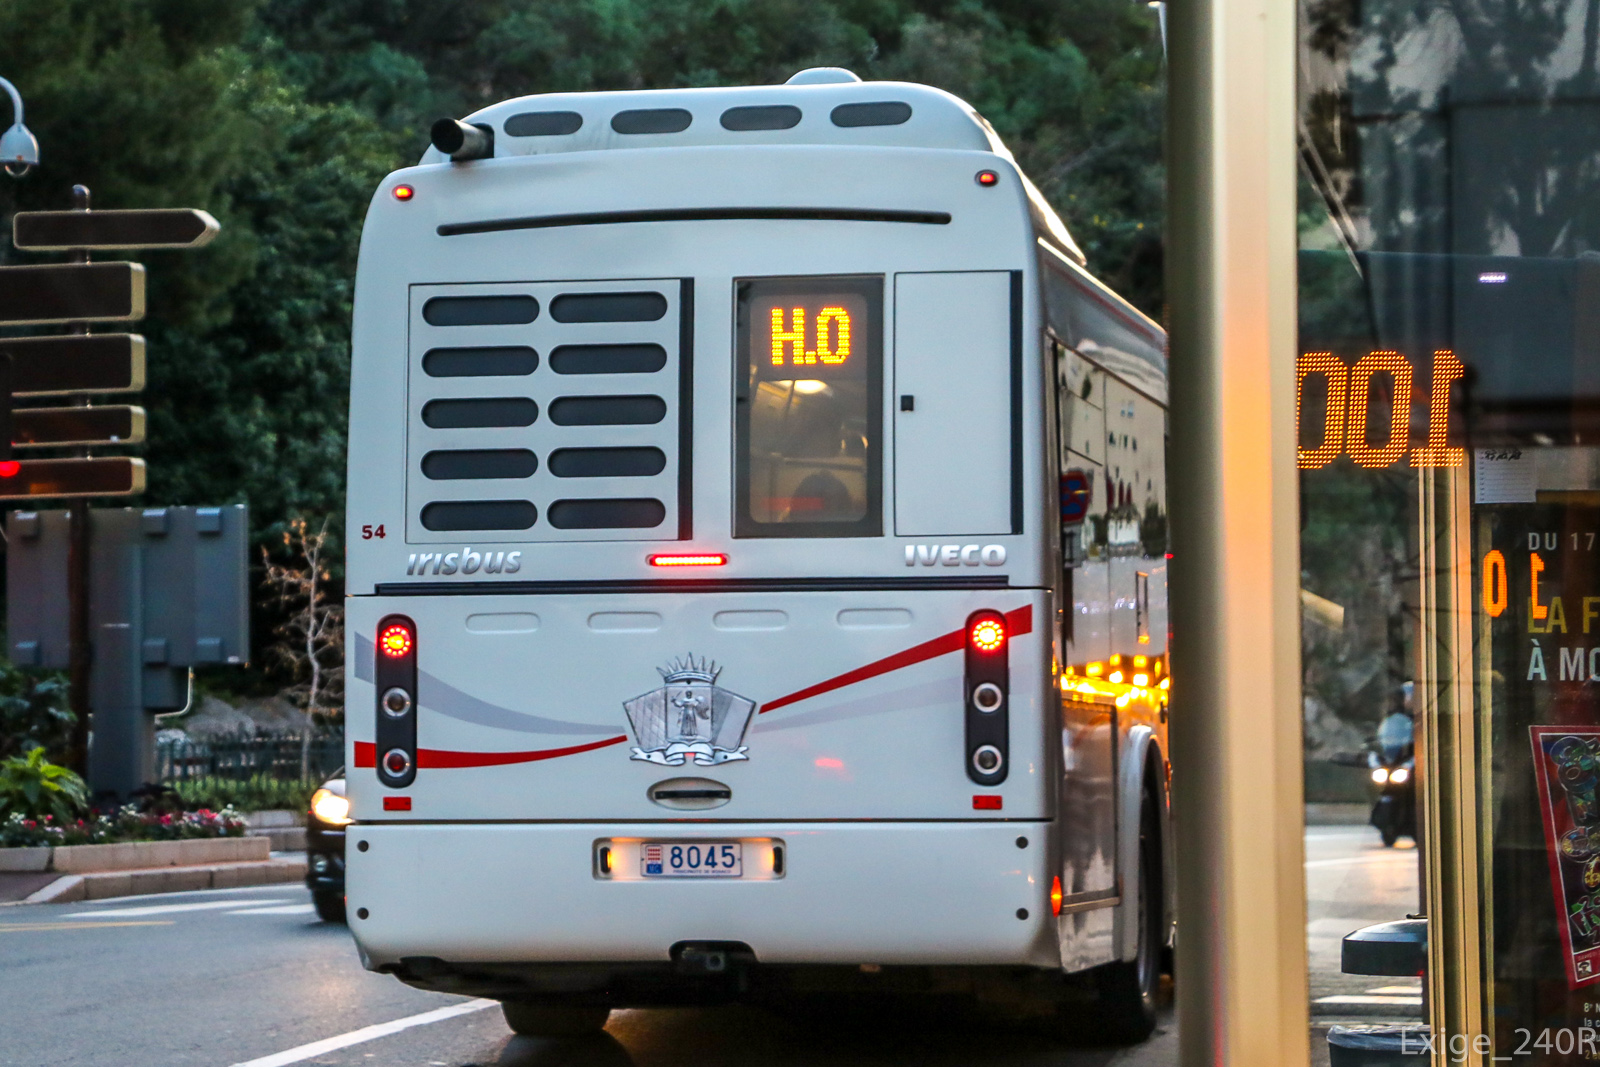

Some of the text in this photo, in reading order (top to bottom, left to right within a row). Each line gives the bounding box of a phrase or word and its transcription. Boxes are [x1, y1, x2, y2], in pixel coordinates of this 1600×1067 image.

[361, 523, 386, 541] 54
[1528, 532, 1596, 551] DU 17
[406, 547, 523, 576] irisbus
[904, 543, 1008, 567] IVECO
[1527, 596, 1568, 634] LA
[1526, 638, 1547, 681] À
[670, 845, 736, 869] 8045
